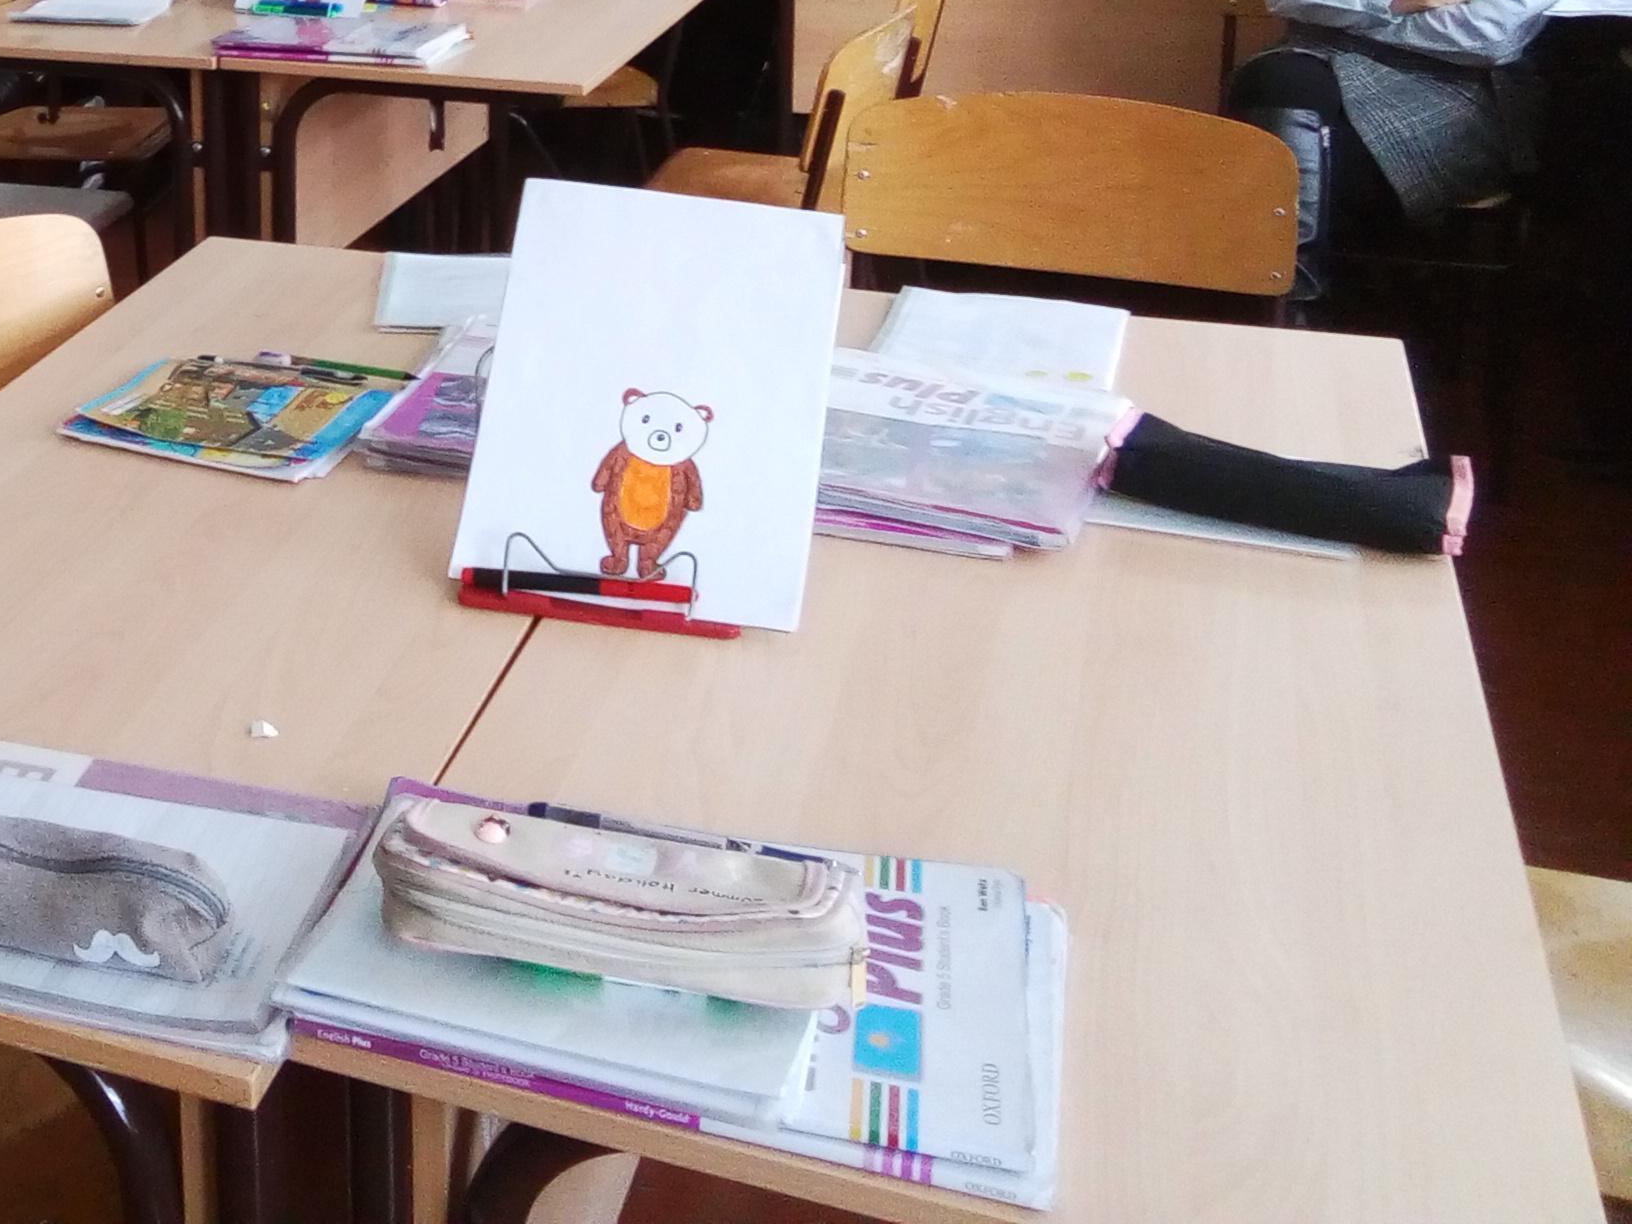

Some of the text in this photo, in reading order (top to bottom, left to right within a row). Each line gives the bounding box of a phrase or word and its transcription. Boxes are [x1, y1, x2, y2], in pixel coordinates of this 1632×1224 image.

[857, 372, 983, 405] Plus
[887, 395, 1086, 441] English
[866, 891, 924, 1005] Plus
[936, 981, 952, 1010] Grade
[317, 1029, 373, 1050] English Plus
[982, 1062, 1002, 1127] OXFORD
